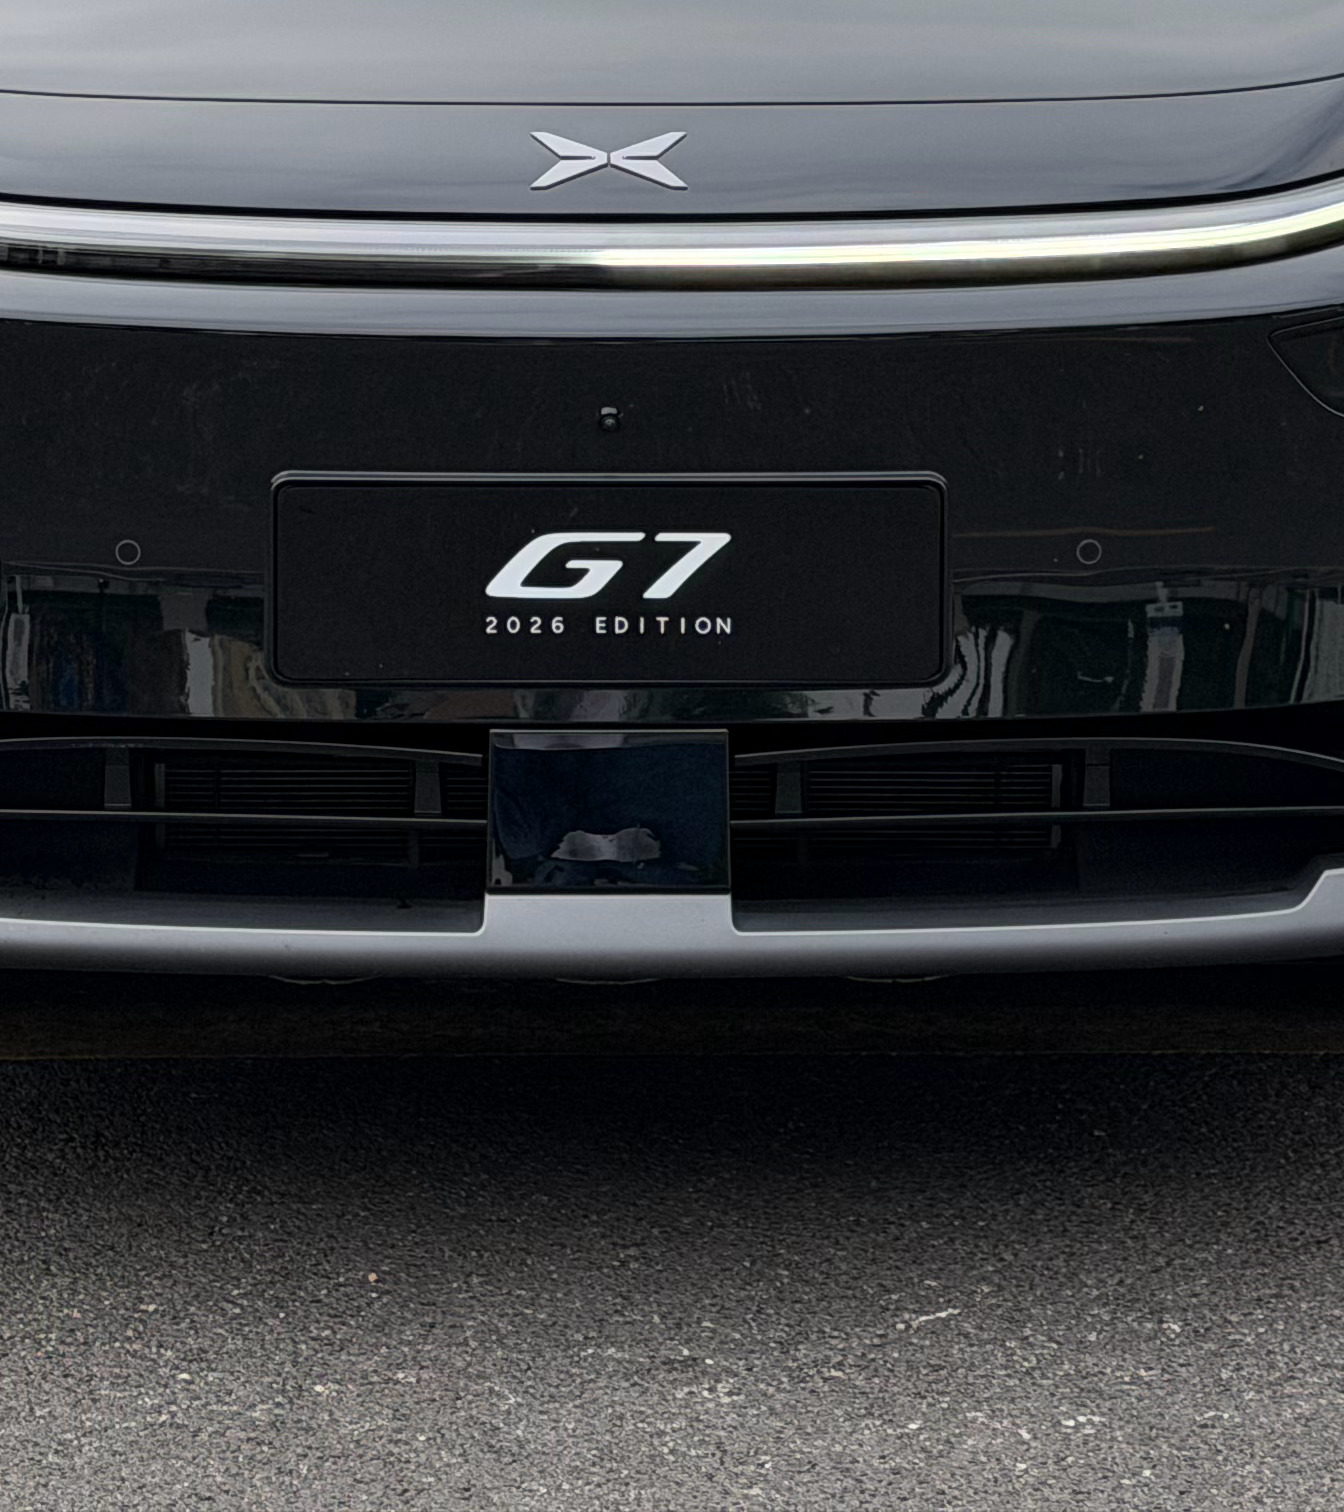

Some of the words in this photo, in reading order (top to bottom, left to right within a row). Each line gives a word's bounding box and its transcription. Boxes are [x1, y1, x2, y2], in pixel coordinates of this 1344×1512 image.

[485, 531, 732, 600] G7
[485, 616, 566, 635] 2026
[594, 616, 733, 635] EDITION
